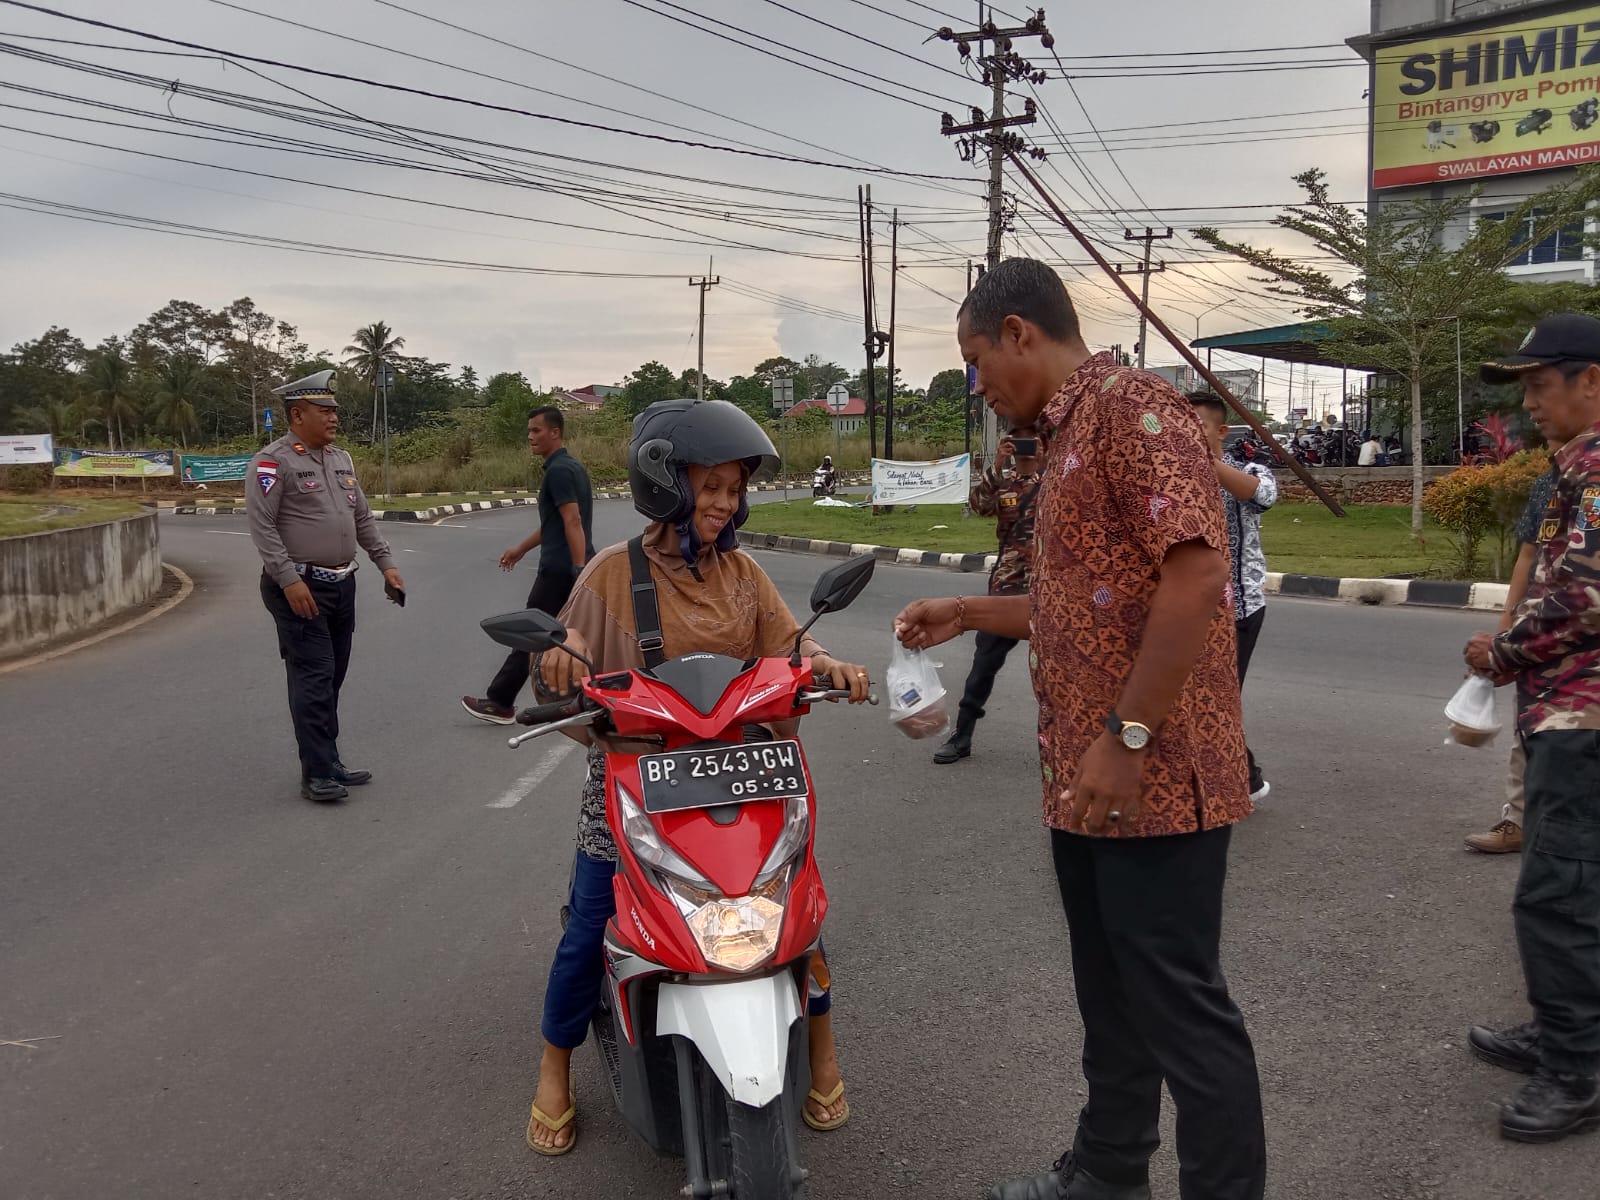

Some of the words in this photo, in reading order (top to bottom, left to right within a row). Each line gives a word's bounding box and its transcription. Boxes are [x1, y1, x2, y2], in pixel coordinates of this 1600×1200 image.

[1399, 87, 1528, 120] Bintangnya
[1438, 154, 1532, 177] SWALAYAN
[1538, 145, 1600, 165] MANDI
[647, 759, 676, 782] BP
[690, 751, 750, 778] 2543
[630, 907, 656, 951] HONDA
